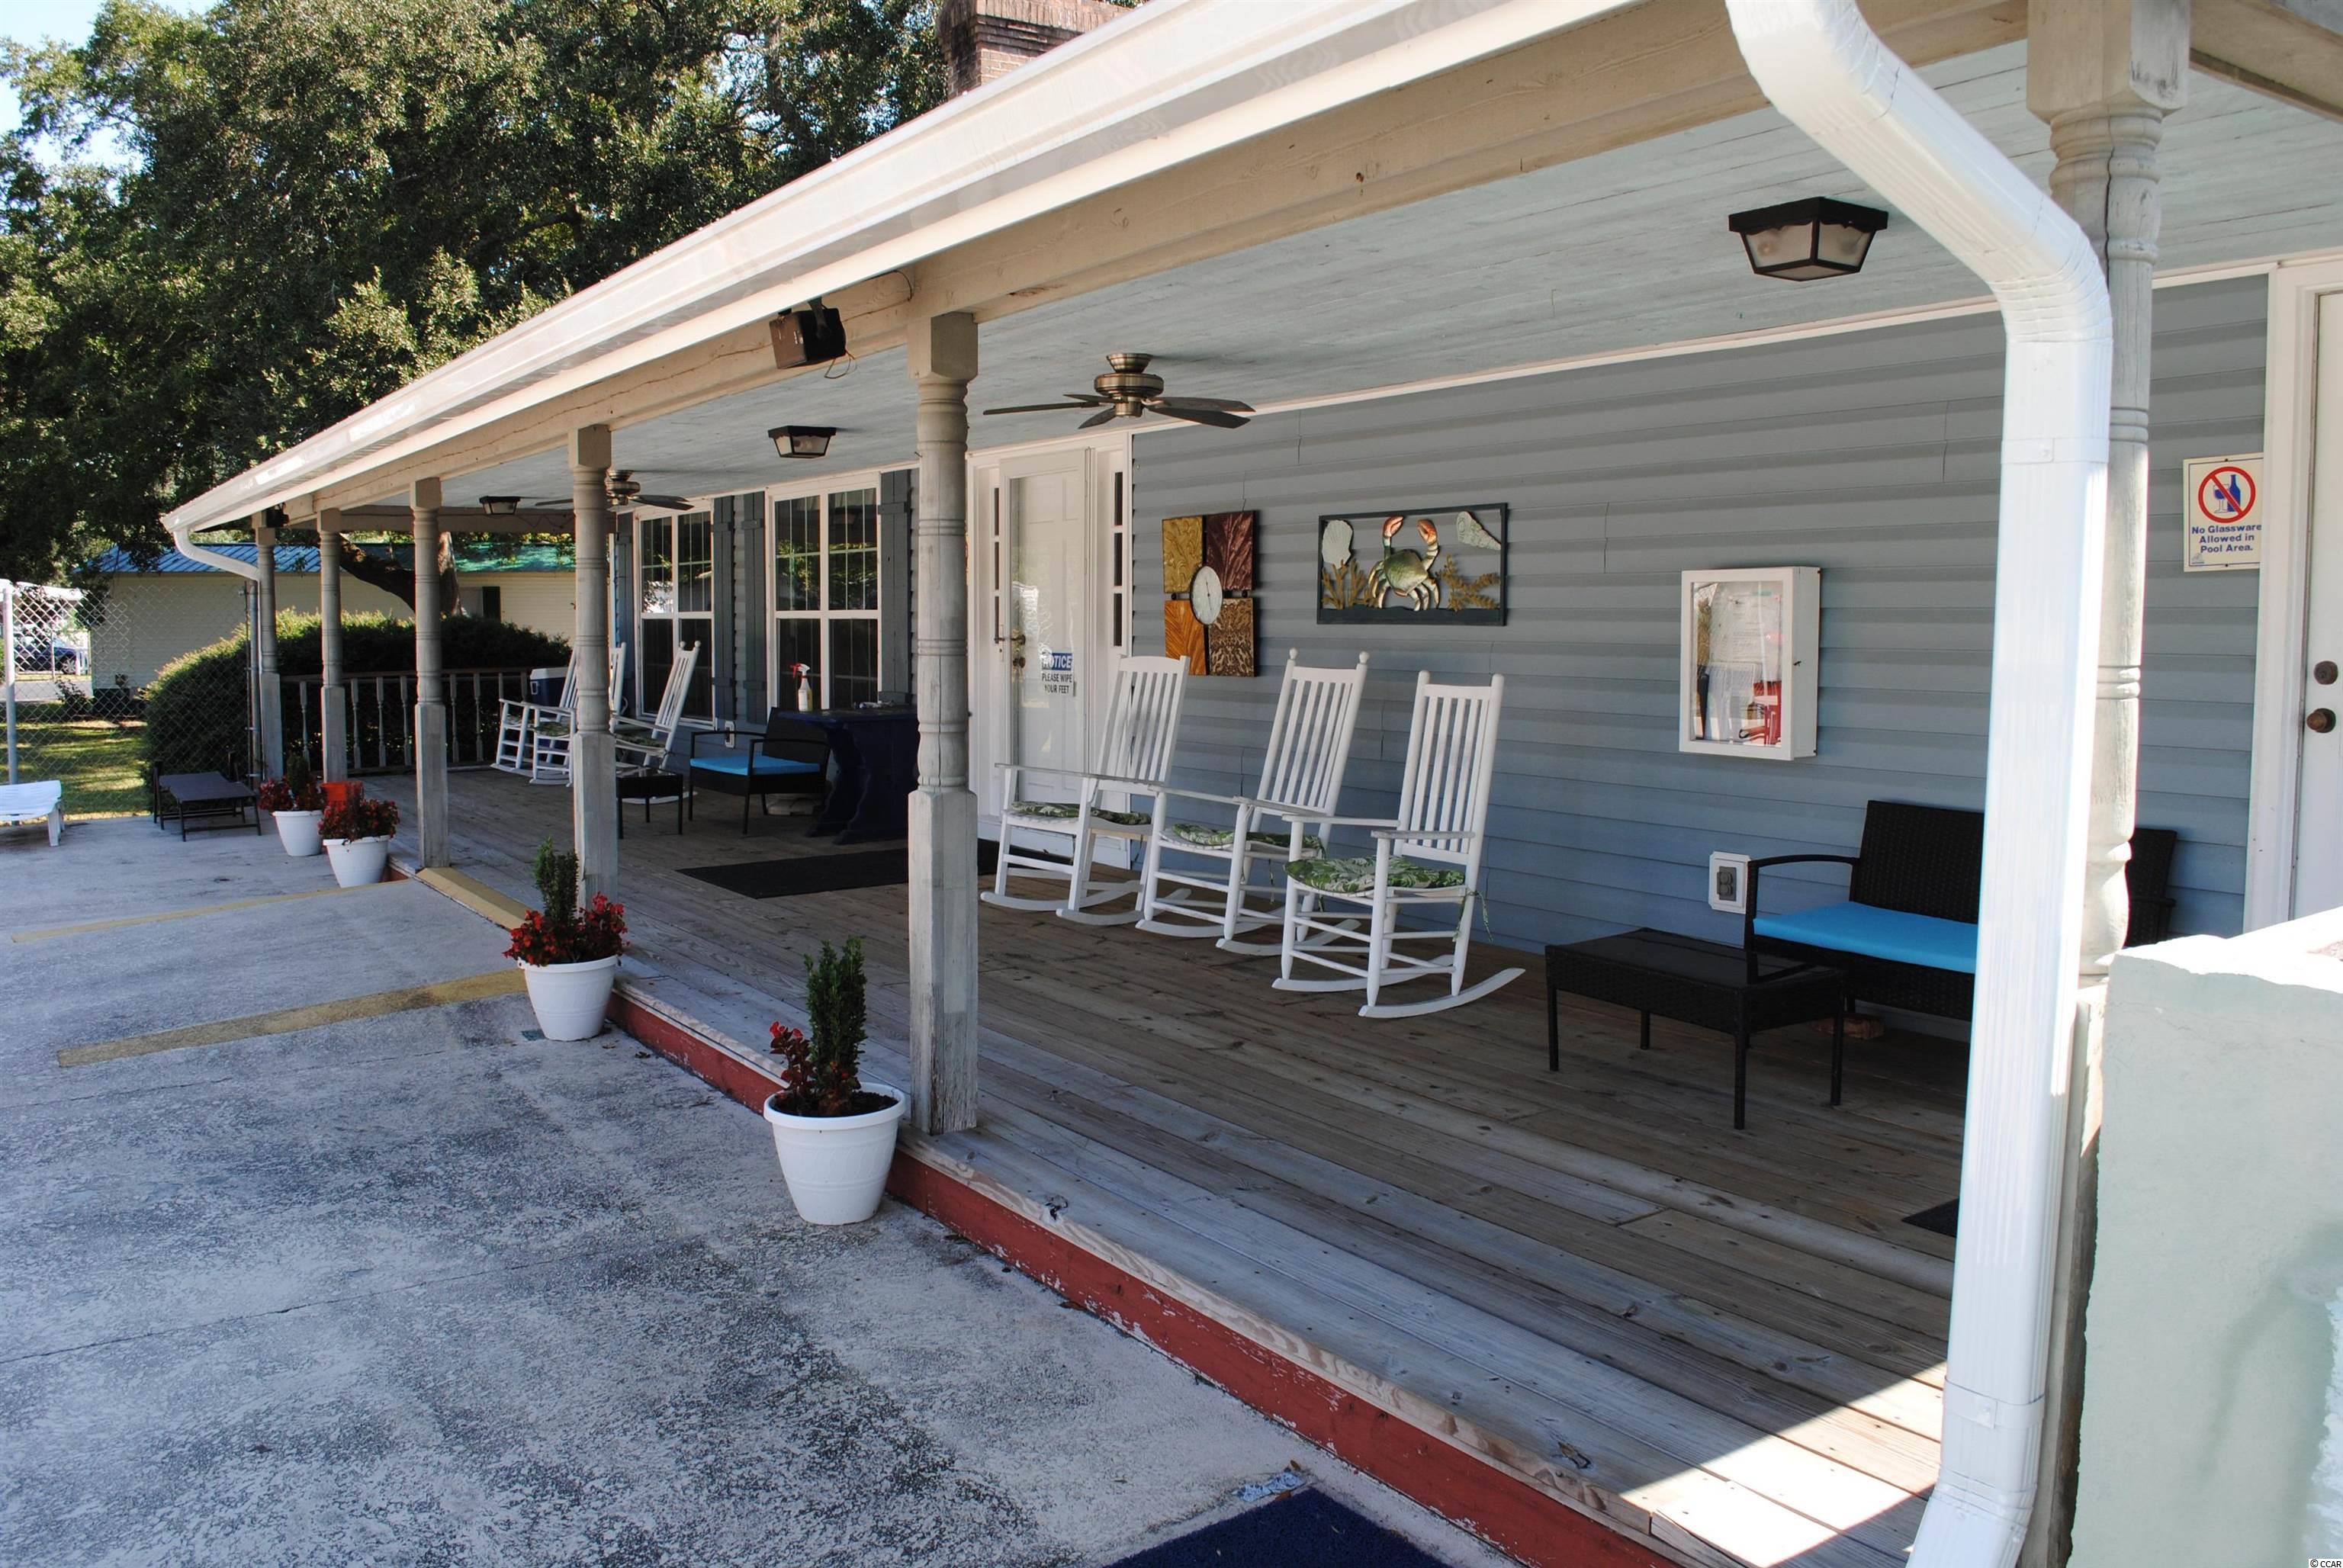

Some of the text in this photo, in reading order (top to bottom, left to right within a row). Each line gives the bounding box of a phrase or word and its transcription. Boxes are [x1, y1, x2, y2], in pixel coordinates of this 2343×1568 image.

[2208, 524, 2262, 533] Glassware
[2199, 535, 2242, 543] Allowed
[2200, 545, 2222, 553] Pool
[1042, 673, 1072, 683] PLEASE WIPE
[1044, 684, 1069, 694] YOUR FEET
